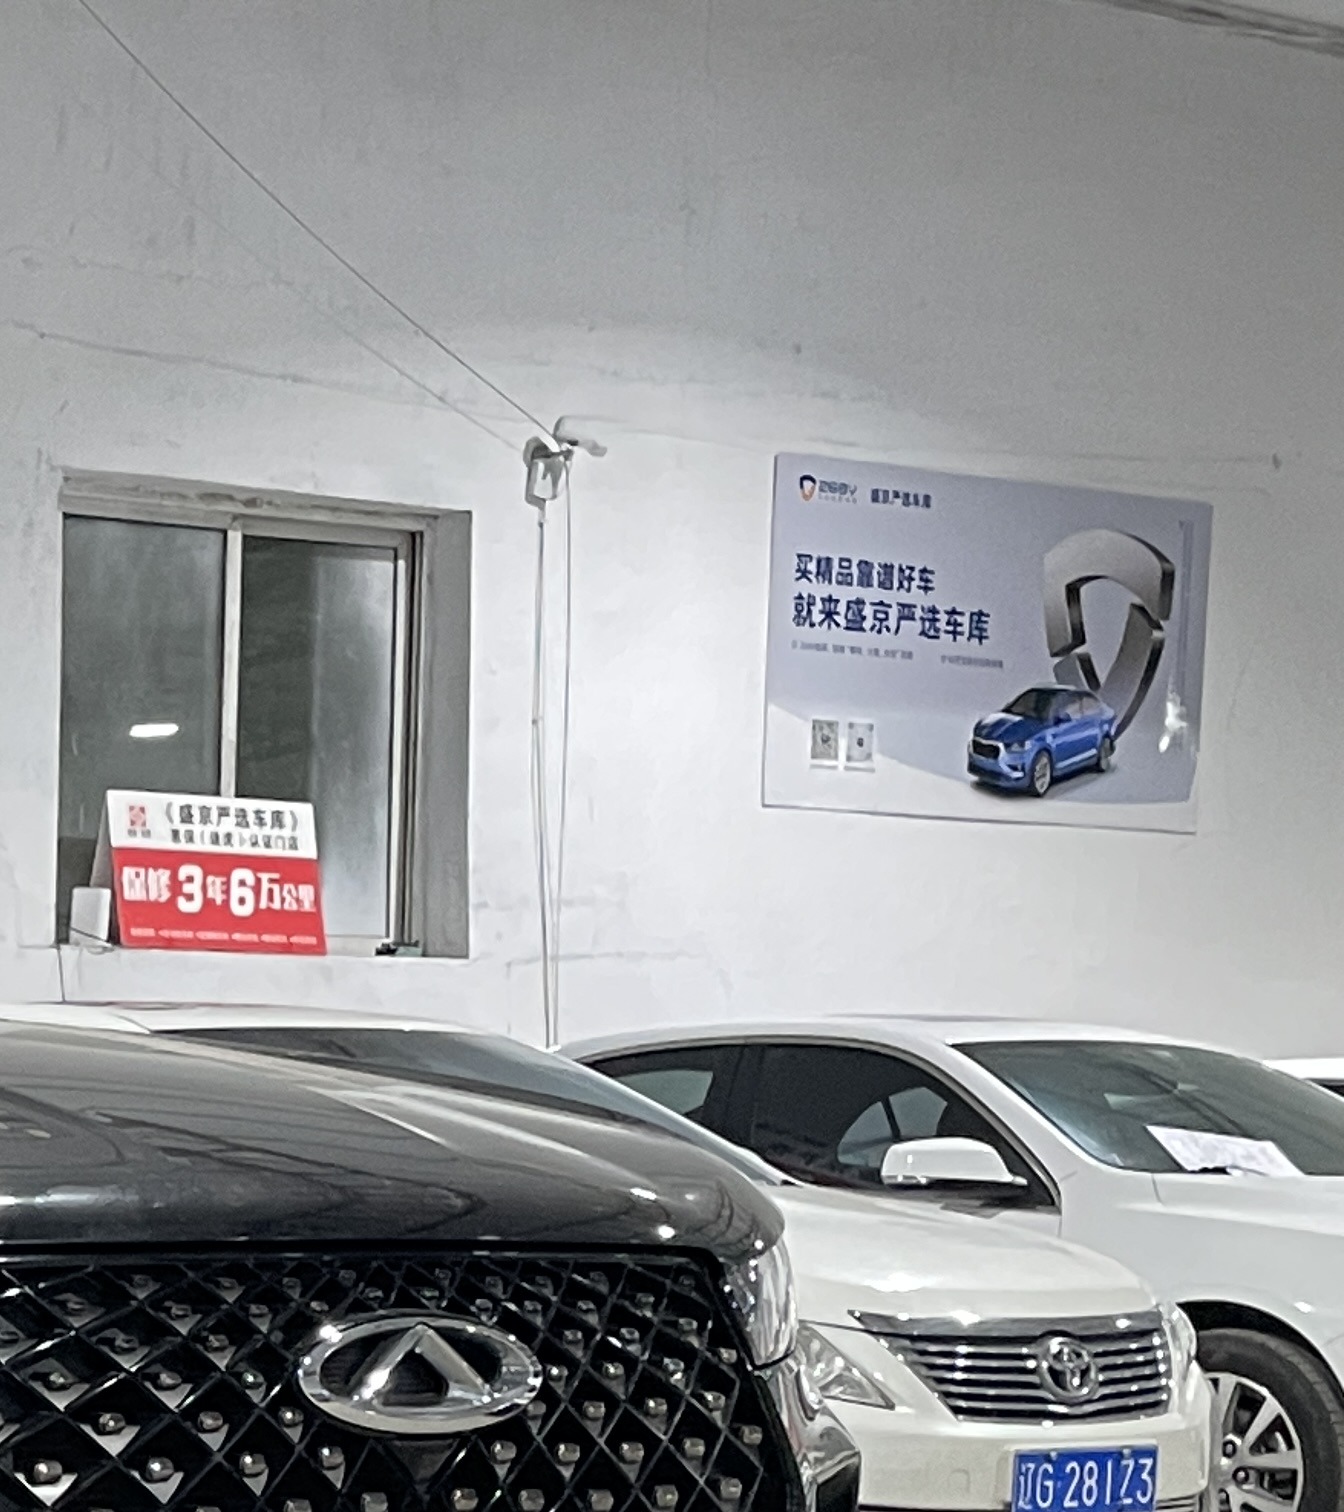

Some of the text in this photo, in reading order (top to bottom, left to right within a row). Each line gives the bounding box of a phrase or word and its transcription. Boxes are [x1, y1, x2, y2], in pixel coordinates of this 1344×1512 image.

[794, 552, 936, 596] 买精品靠谱好车
[791, 591, 991, 646] 就来盛京严选车库
